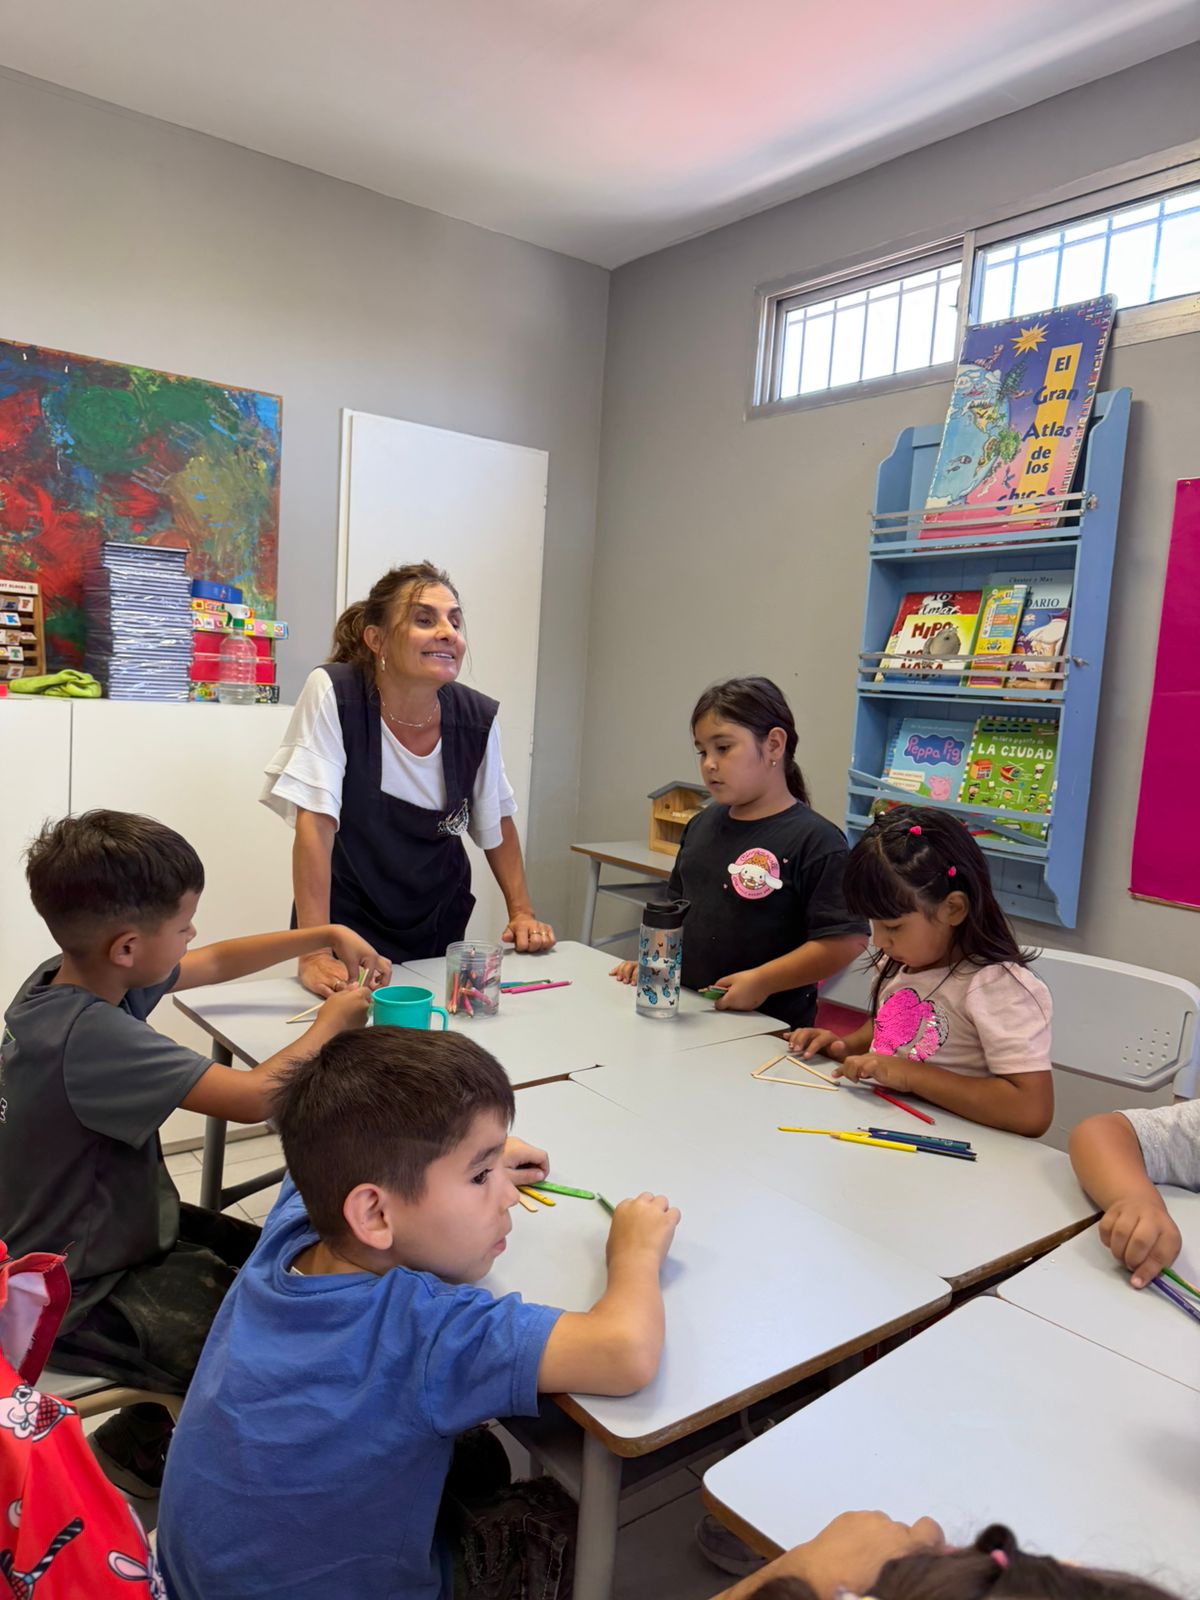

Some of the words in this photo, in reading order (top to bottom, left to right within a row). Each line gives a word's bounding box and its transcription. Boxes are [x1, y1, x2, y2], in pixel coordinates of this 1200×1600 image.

[1055, 355, 1072, 372] El
[1032, 385, 1080, 406] Gran
[1022, 421, 1073, 442] Atlas
[1031, 446, 1051, 461] de
[1025, 461, 1049, 475] los
[908, 736, 941, 760] Peppa
[943, 739, 961, 763] Pig
[977, 743, 996, 756] LA
[1001, 745, 1054, 760] CIUDAD
